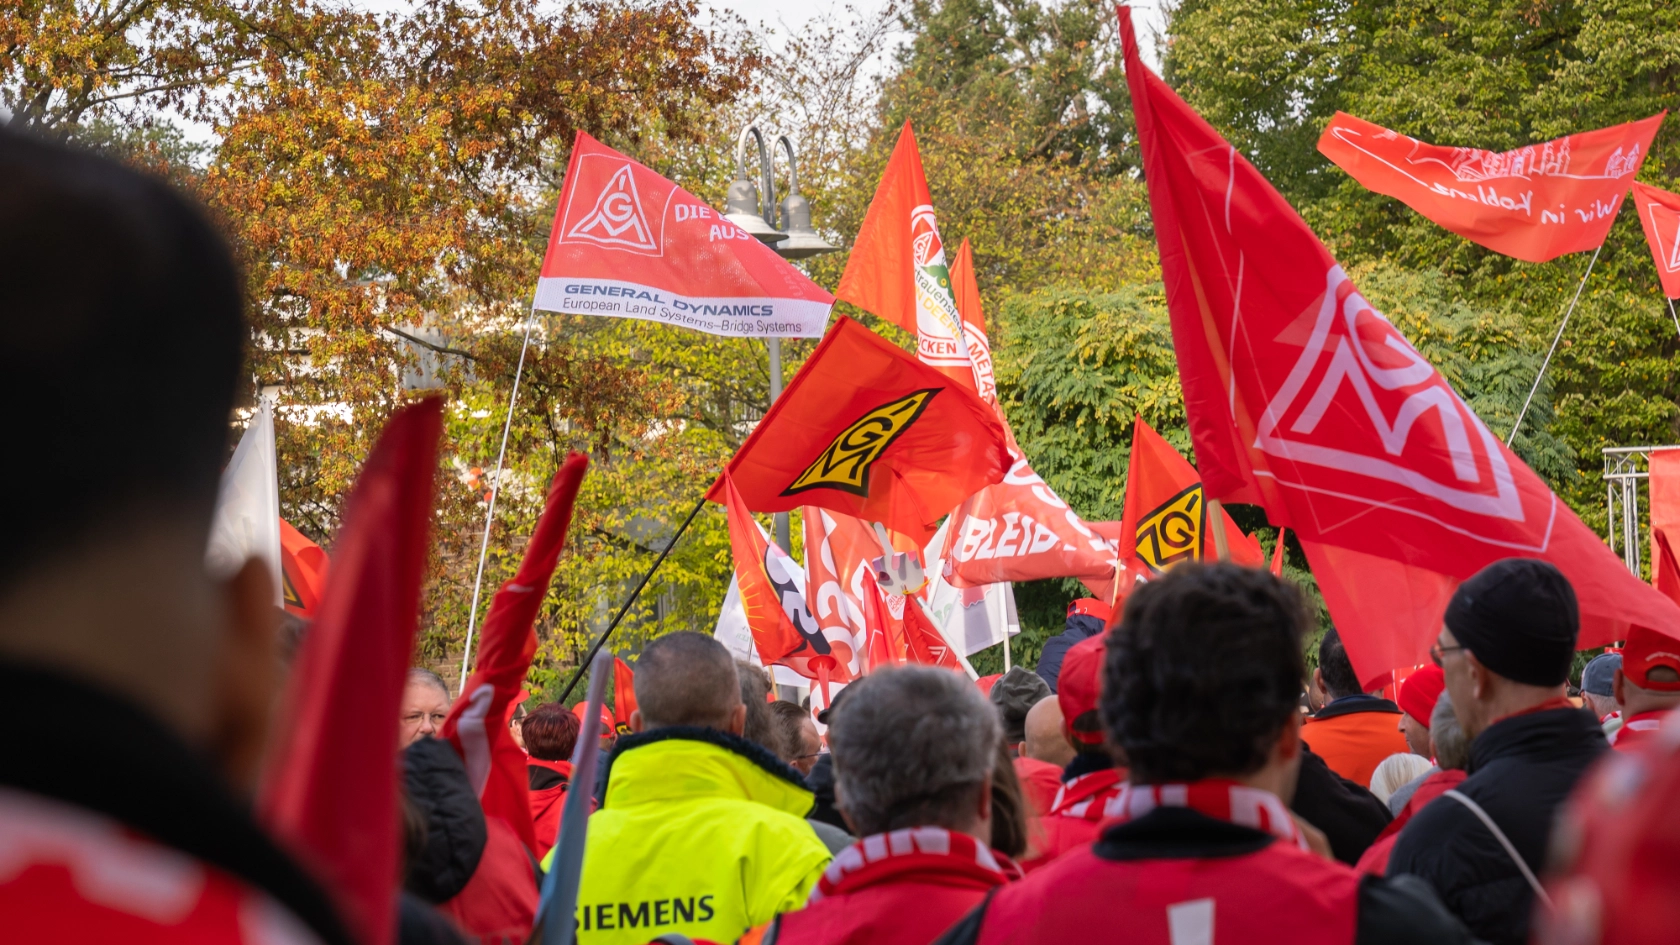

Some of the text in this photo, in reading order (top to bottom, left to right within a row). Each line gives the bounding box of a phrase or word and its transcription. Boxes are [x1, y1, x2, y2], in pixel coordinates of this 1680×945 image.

[675, 204, 711, 222] DIE
[709, 224, 749, 242] AUS
[563, 297, 621, 313] European
[625, 301, 657, 316] Land
[756, 319, 802, 335] Systems
[565, 284, 774, 317] GENERAL DYNAMICS
[968, 342, 995, 402] META
[575, 895, 715, 931] IEMENS
